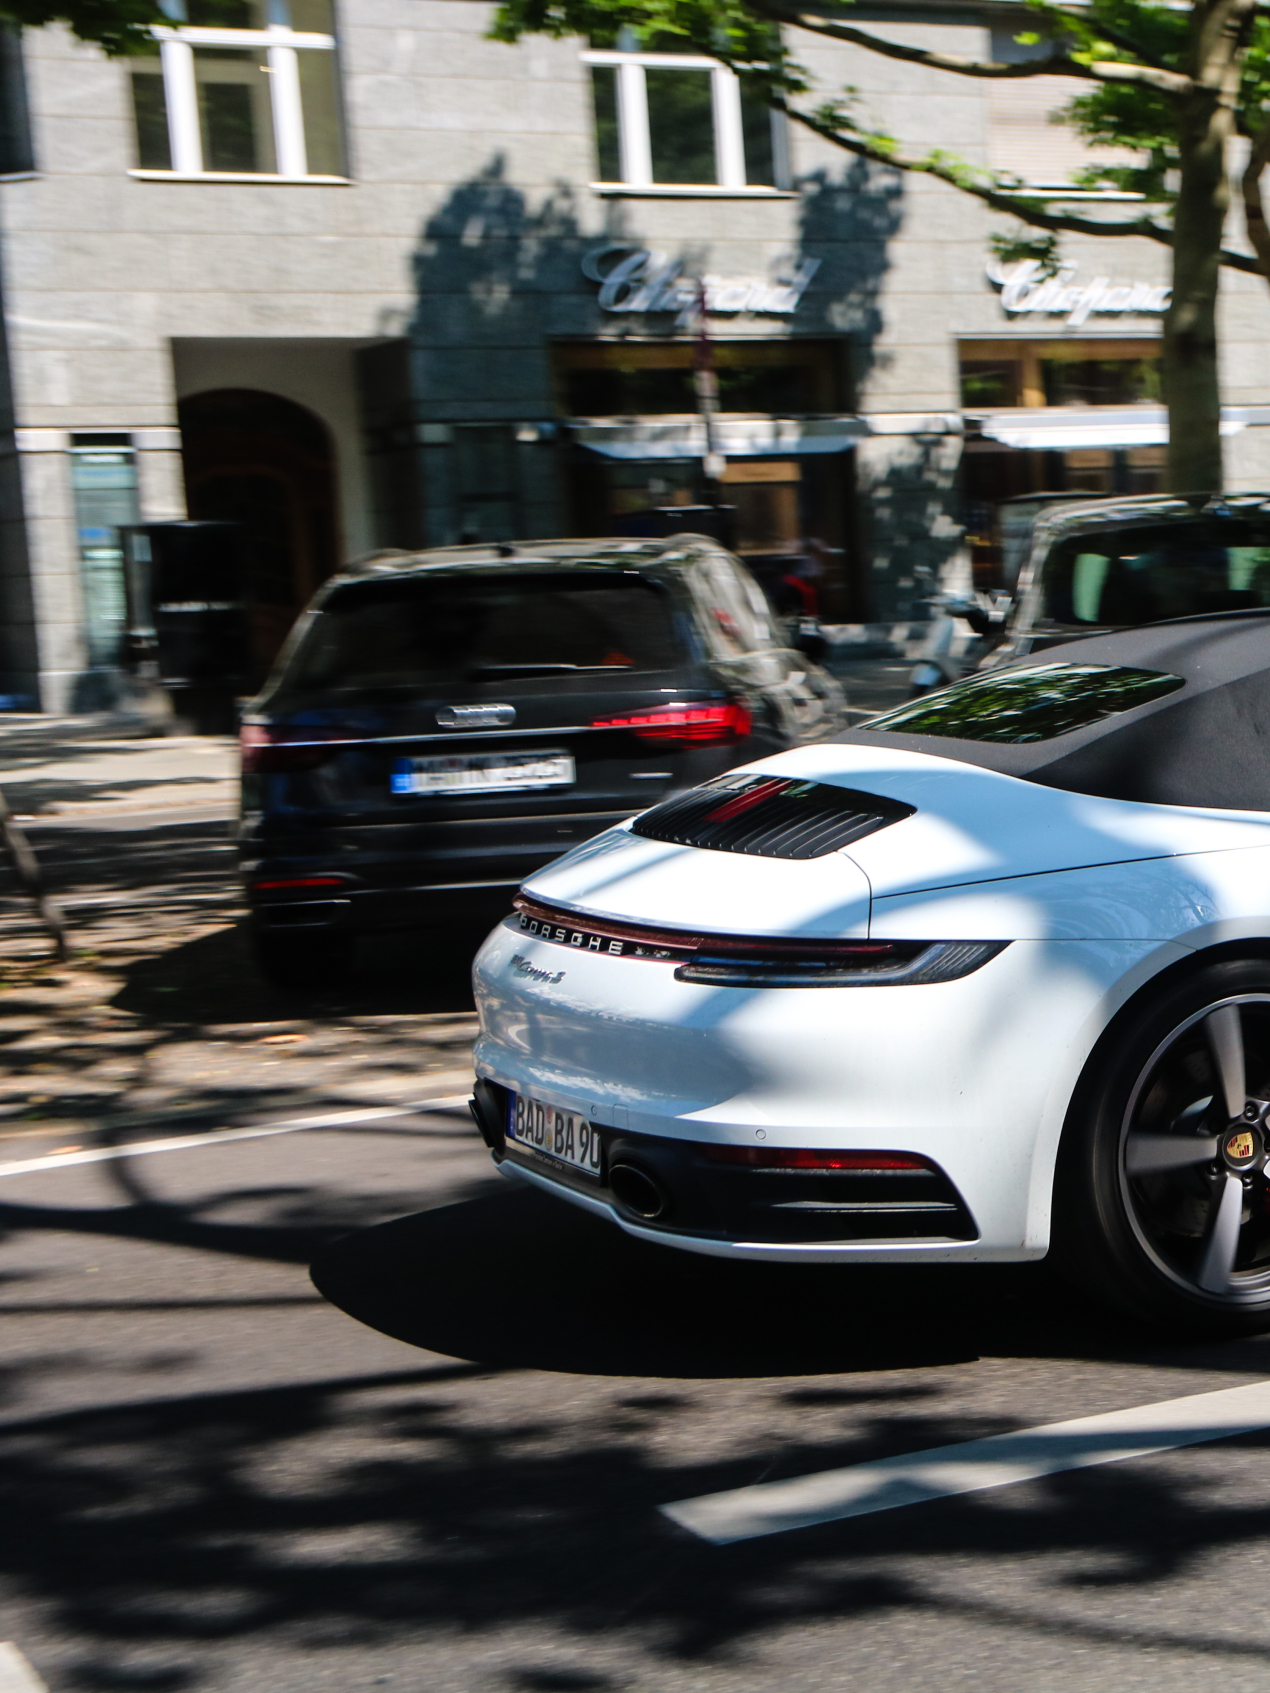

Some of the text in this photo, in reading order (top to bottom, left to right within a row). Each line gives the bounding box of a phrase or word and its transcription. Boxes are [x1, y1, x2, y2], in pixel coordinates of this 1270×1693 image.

[519, 913, 625, 956] PORSCHE
[516, 1095, 545, 1146] BAD
[554, 1112, 575, 1160] BA
